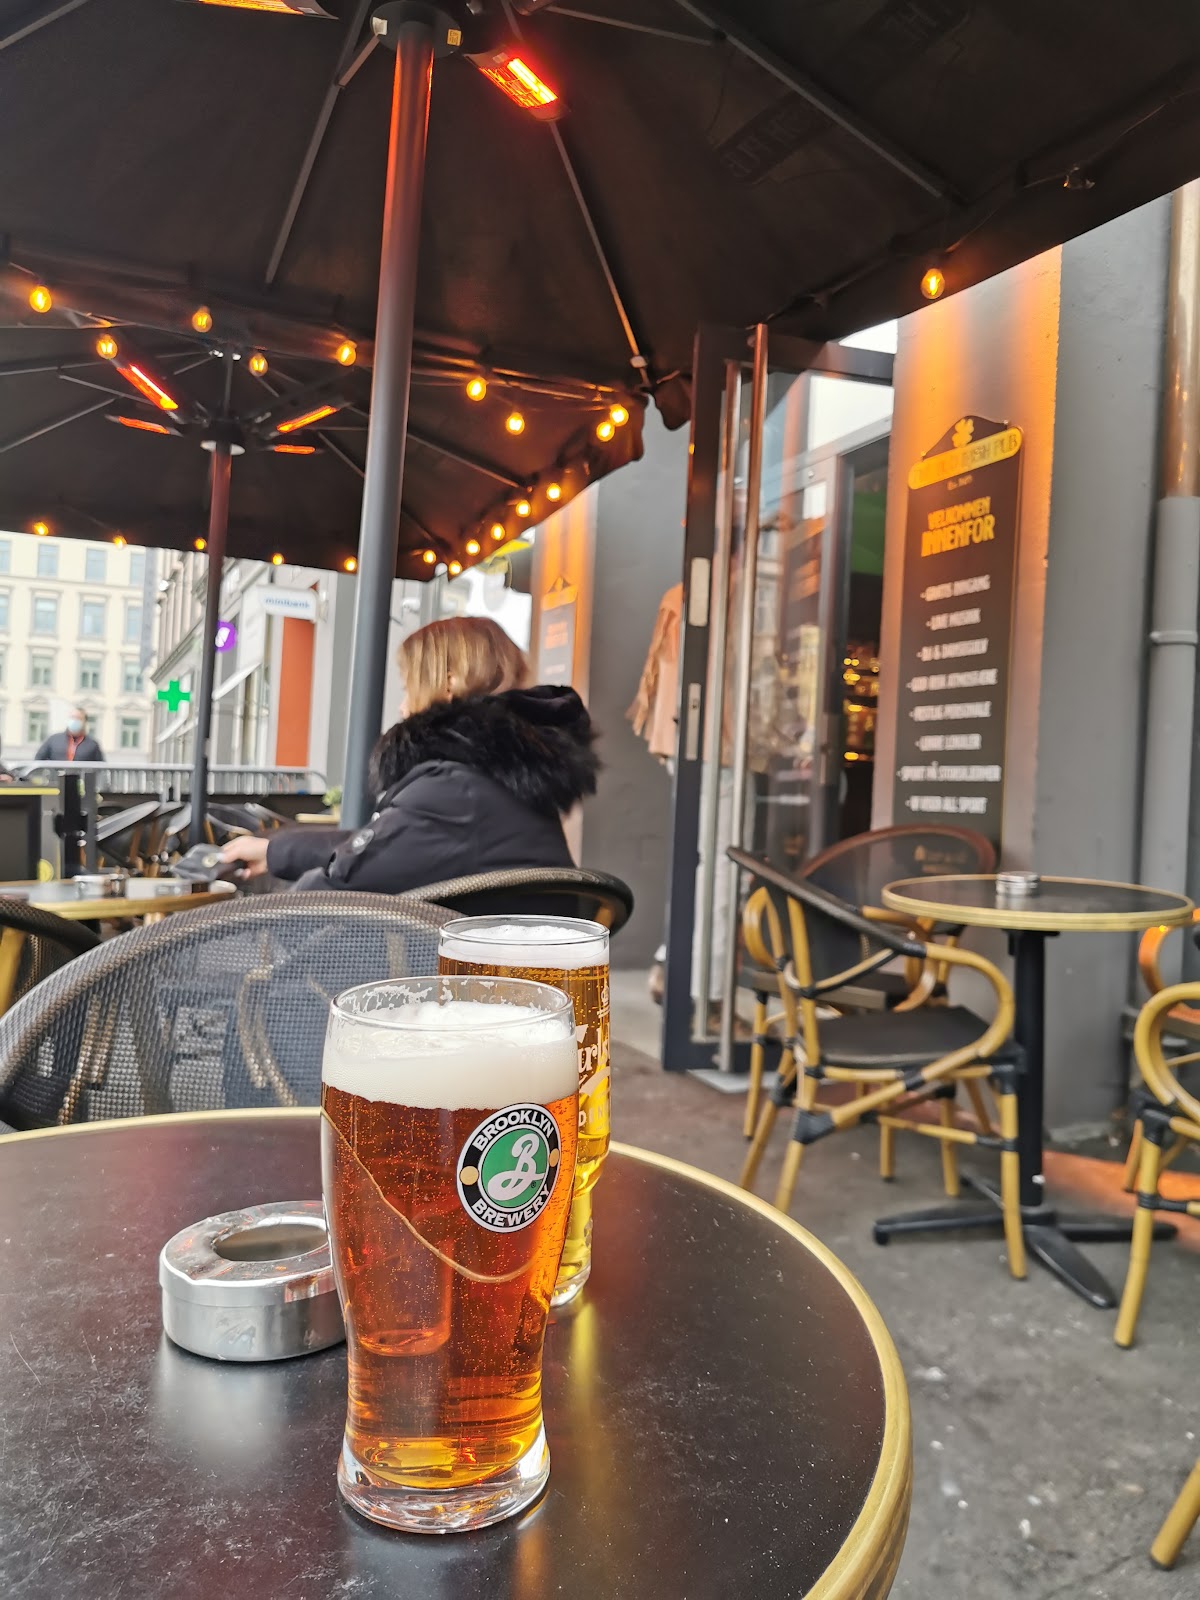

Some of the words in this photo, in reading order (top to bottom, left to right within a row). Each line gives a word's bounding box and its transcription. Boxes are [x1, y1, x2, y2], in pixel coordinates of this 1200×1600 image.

[921, 514, 995, 557] INNENFOR
[472, 1110, 554, 1151] BROOKLYN
[472, 1184, 550, 1227] BREWERY
